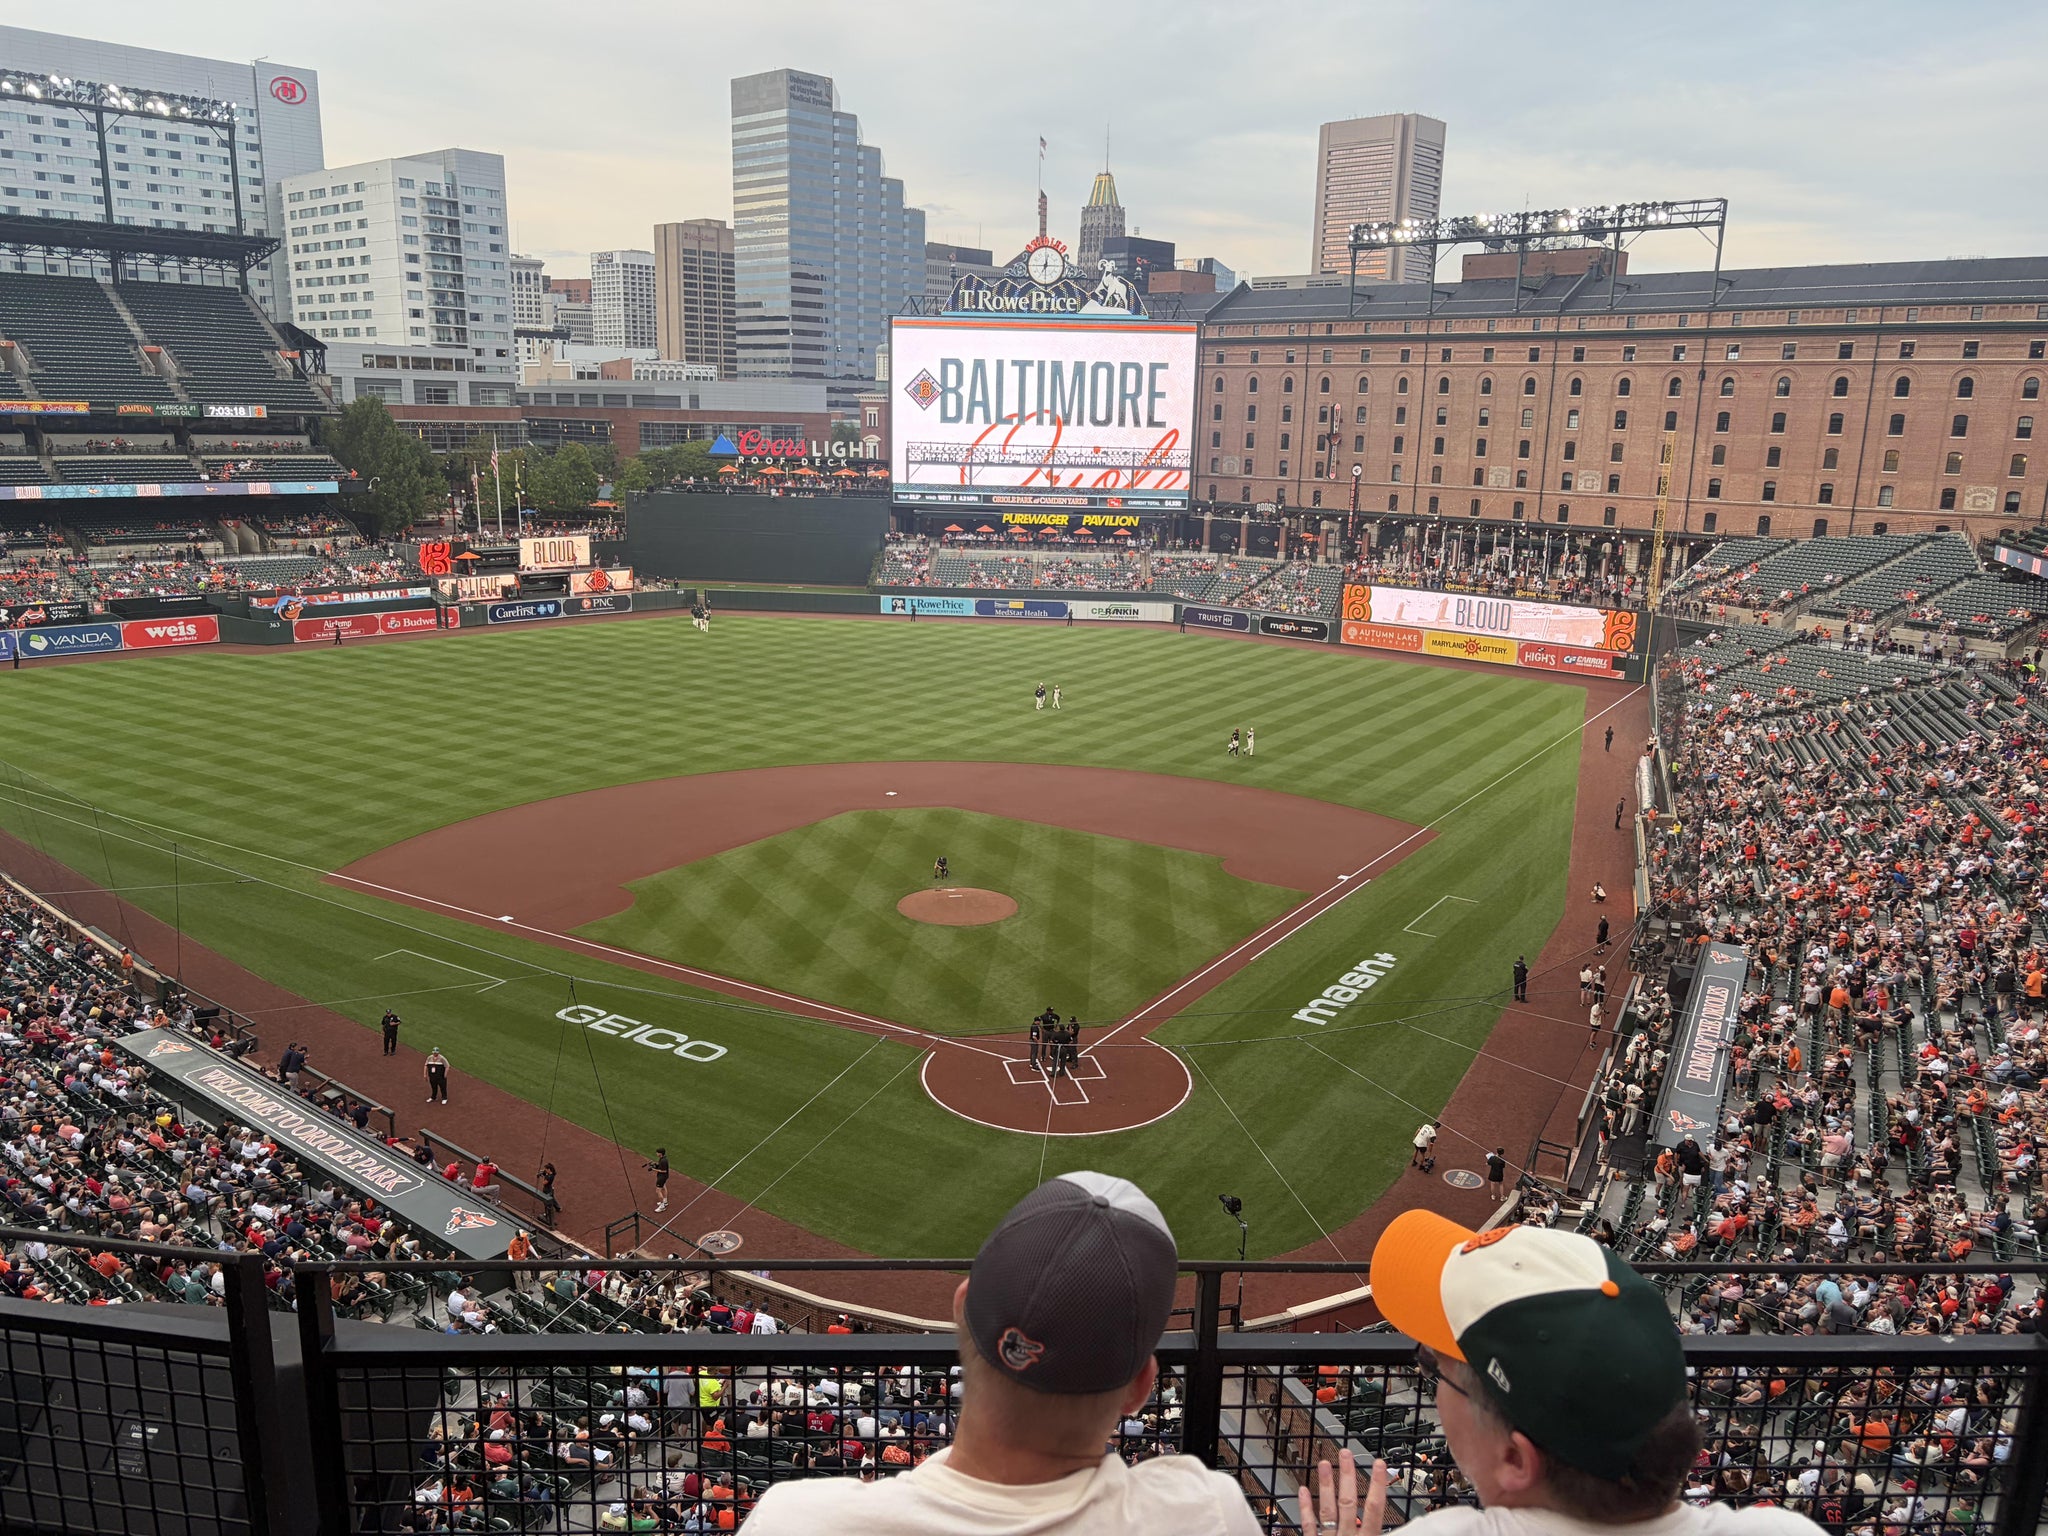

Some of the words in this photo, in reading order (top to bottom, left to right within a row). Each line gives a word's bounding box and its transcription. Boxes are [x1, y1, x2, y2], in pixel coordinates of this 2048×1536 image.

[1031, 291, 1077, 312] Price
[940, 358, 1169, 428] BALTIMORE
[209, 406, 245, 416] 7:03:18
[738, 429, 807, 457] Coors
[812, 440, 878, 459] LIGHT
[739, 456, 786, 465] ROOF
[802, 457, 848, 467] DECK
[992, 495, 1017, 503] ORIOLE
[1017, 496, 1033, 504] PARK
[1040, 496, 1066, 504] CAMDEN
[1067, 497, 1088, 505] YARDS
[1002, 512, 1069, 526] PUREWAGER
[1082, 515, 1140, 527] PAVILION
[533, 540, 574, 564] BLOUD
[343, 591, 370, 602] BIRD
[372, 589, 400, 600] BATH
[592, 597, 614, 608] PNC
[495, 605, 537, 619] CareFirst
[942, 600, 964, 610] Price
[994, 608, 1022, 617] MedStar
[1024, 609, 1048, 617] Health
[1198, 613, 1223, 622] TRUIST
[1455, 598, 1512, 631] BLOUD
[144, 621, 197, 638] weis
[1359, 626, 1395, 639] AUTUMN
[1398, 631, 1418, 642] LAKE
[48, 632, 113, 646] VANDA
[1431, 639, 1465, 650] MARYLAND
[1525, 651, 1556, 666] HIGH'S
[1577, 655, 1608, 665] CARROLL
[555, 1004, 729, 1062] GEICO
[1686, 1049, 1716, 1083] HOME
[199, 1069, 285, 1116] WELCOME
[274, 1109, 305, 1129] TO
[291, 1122, 364, 1167] ORIOLE
[347, 1152, 412, 1192] PARK
